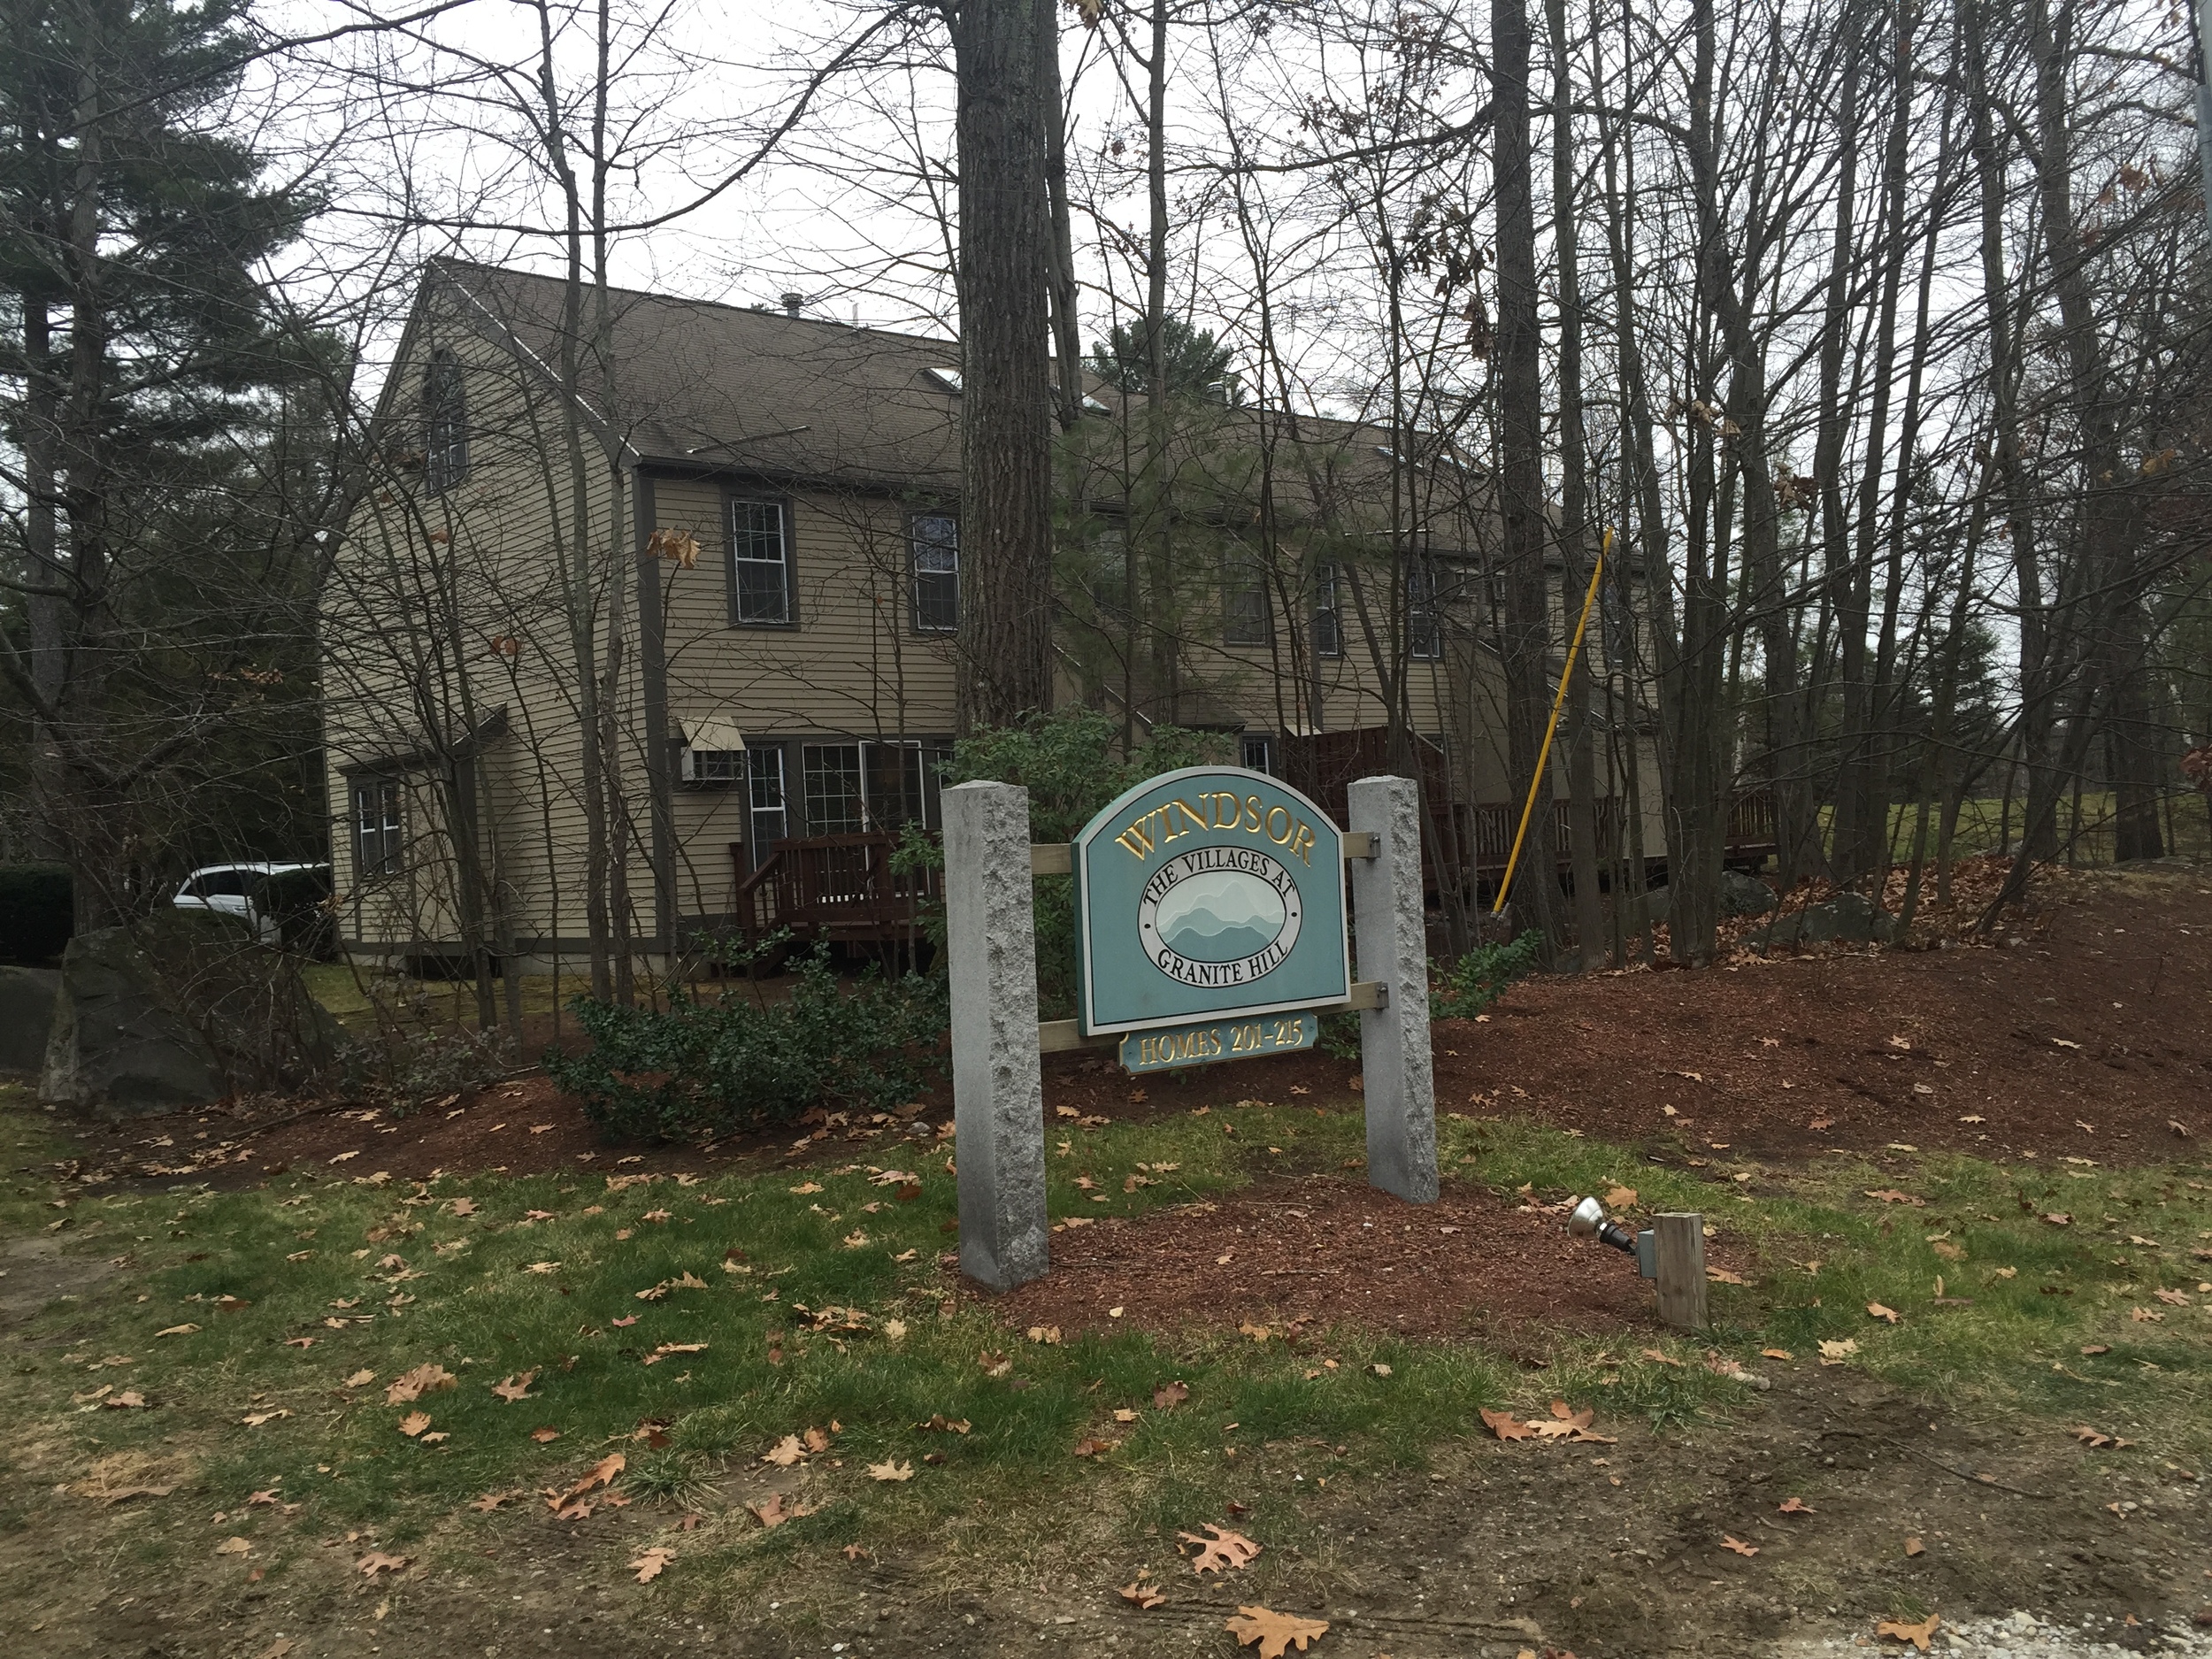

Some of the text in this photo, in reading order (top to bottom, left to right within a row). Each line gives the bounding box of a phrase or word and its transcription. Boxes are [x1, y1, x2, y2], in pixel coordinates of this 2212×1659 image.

[1115, 791, 1317, 868] WINDSOR
[1143, 849, 1295, 907] THE VILLAGES AT
[1157, 940, 1288, 986] GRANITE HILL
[1139, 1019, 1303, 1065] HOMES 201-215
